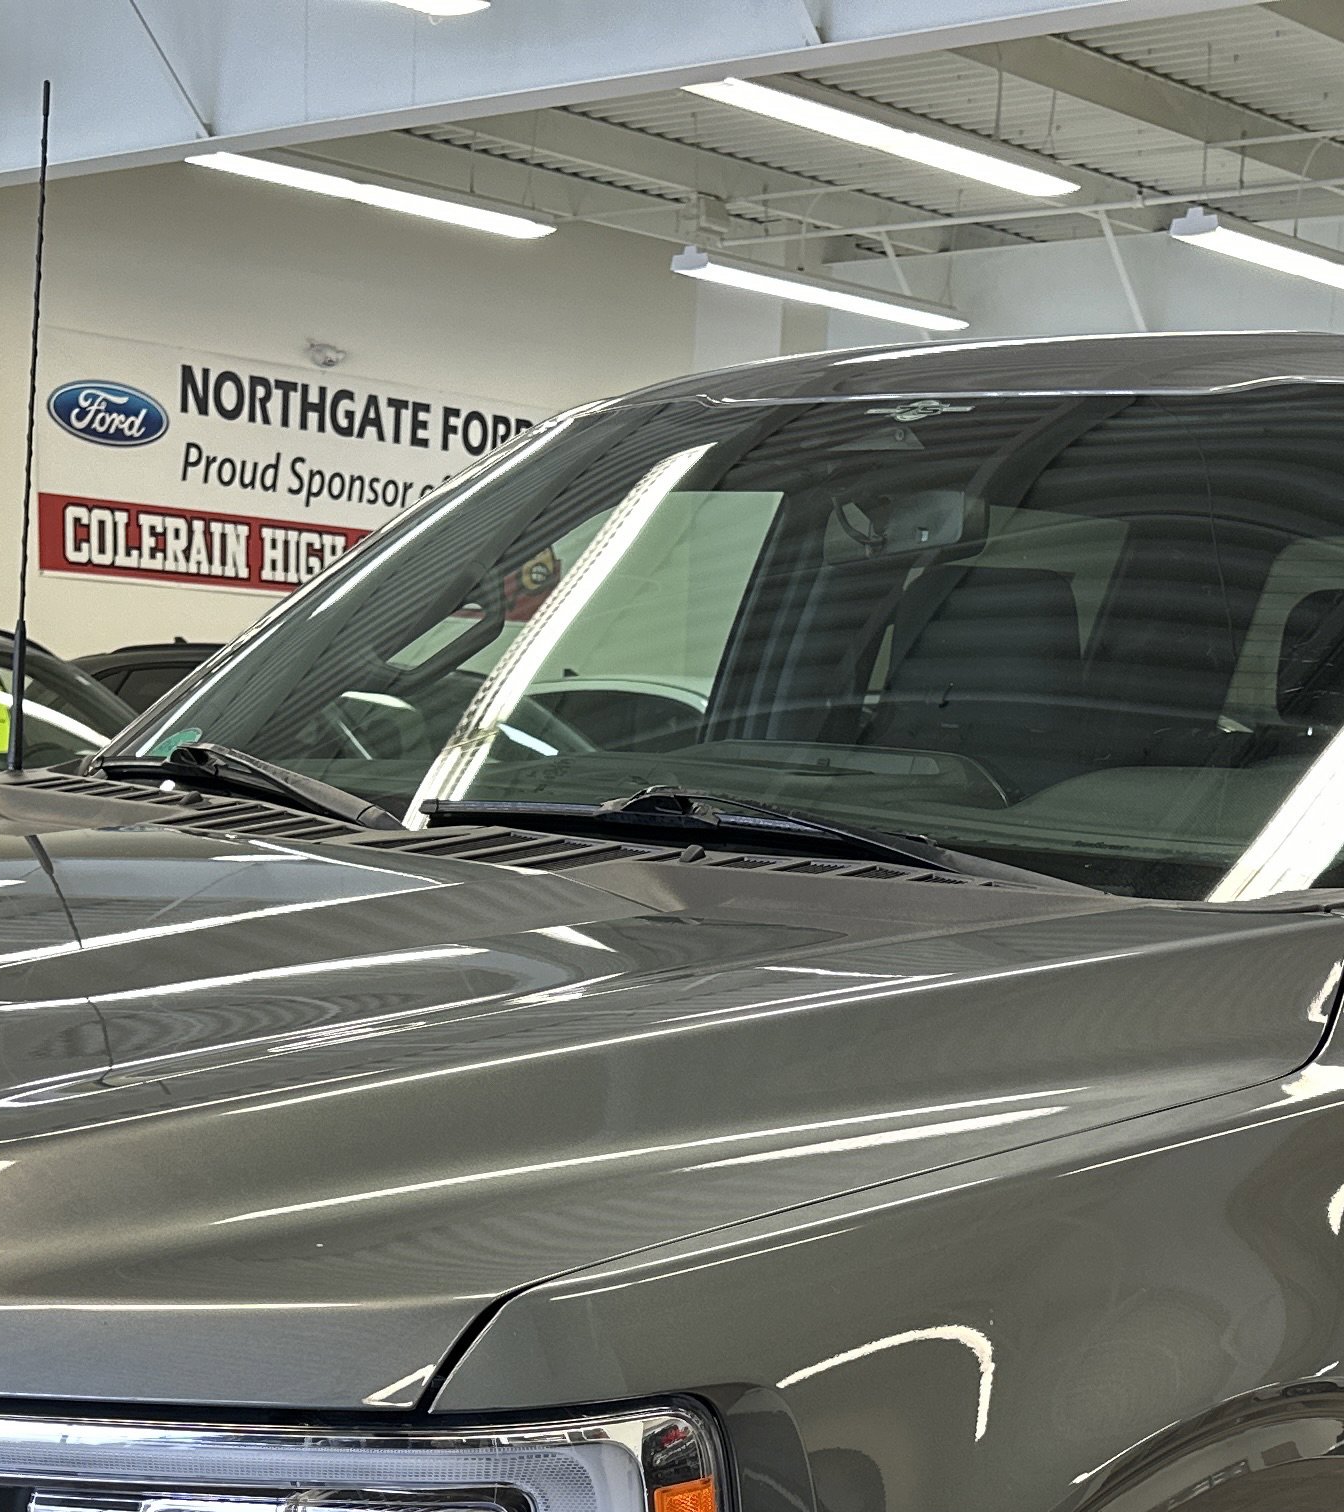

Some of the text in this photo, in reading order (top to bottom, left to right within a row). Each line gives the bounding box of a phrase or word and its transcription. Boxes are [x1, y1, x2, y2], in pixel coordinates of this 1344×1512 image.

[69, 389, 148, 438] Ford
[179, 364, 431, 449] NORTHGATE
[181, 442, 282, 493] Proud
[287, 456, 414, 508] Sponsor
[62, 502, 251, 580] COLERAIN
